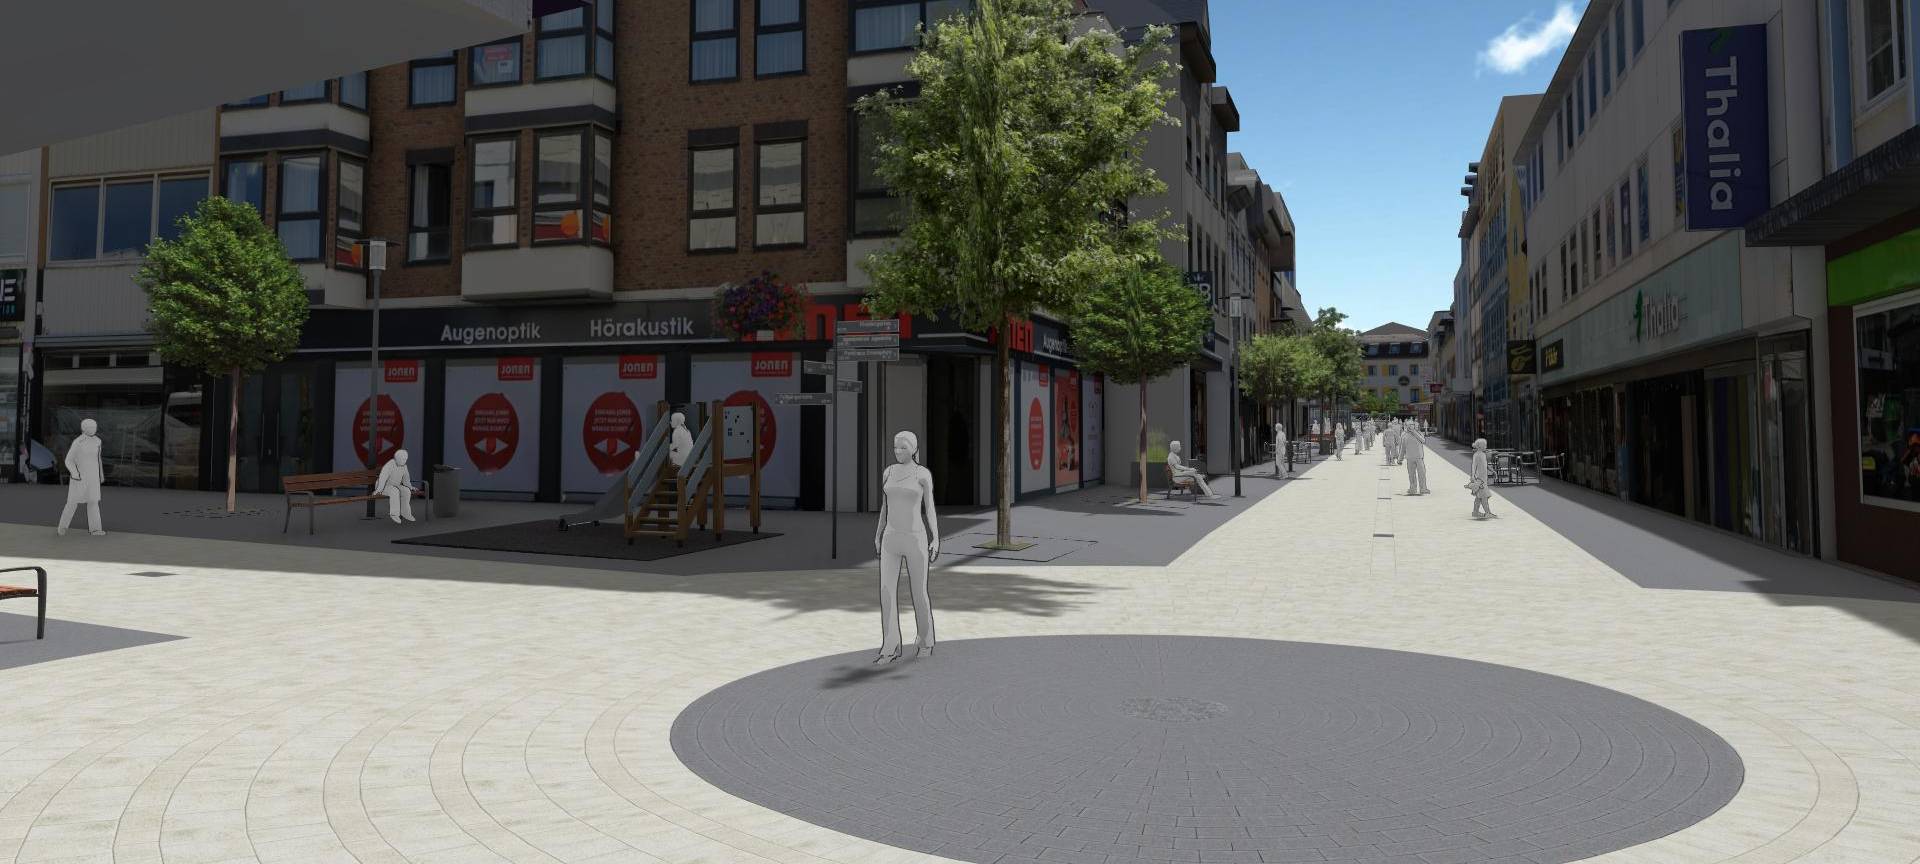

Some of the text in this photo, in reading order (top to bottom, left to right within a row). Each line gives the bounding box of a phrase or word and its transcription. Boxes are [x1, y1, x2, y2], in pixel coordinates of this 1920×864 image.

[1705, 56, 1742, 211] Thalia
[1645, 292, 1679, 338] Thalia
[440, 316, 694, 344] Augenoptik Hörakustik
[500, 365, 530, 375] JONEN
[623, 363, 654, 373] JONEN
[753, 360, 789, 371] JONEN
[387, 367, 415, 377] JONEN
